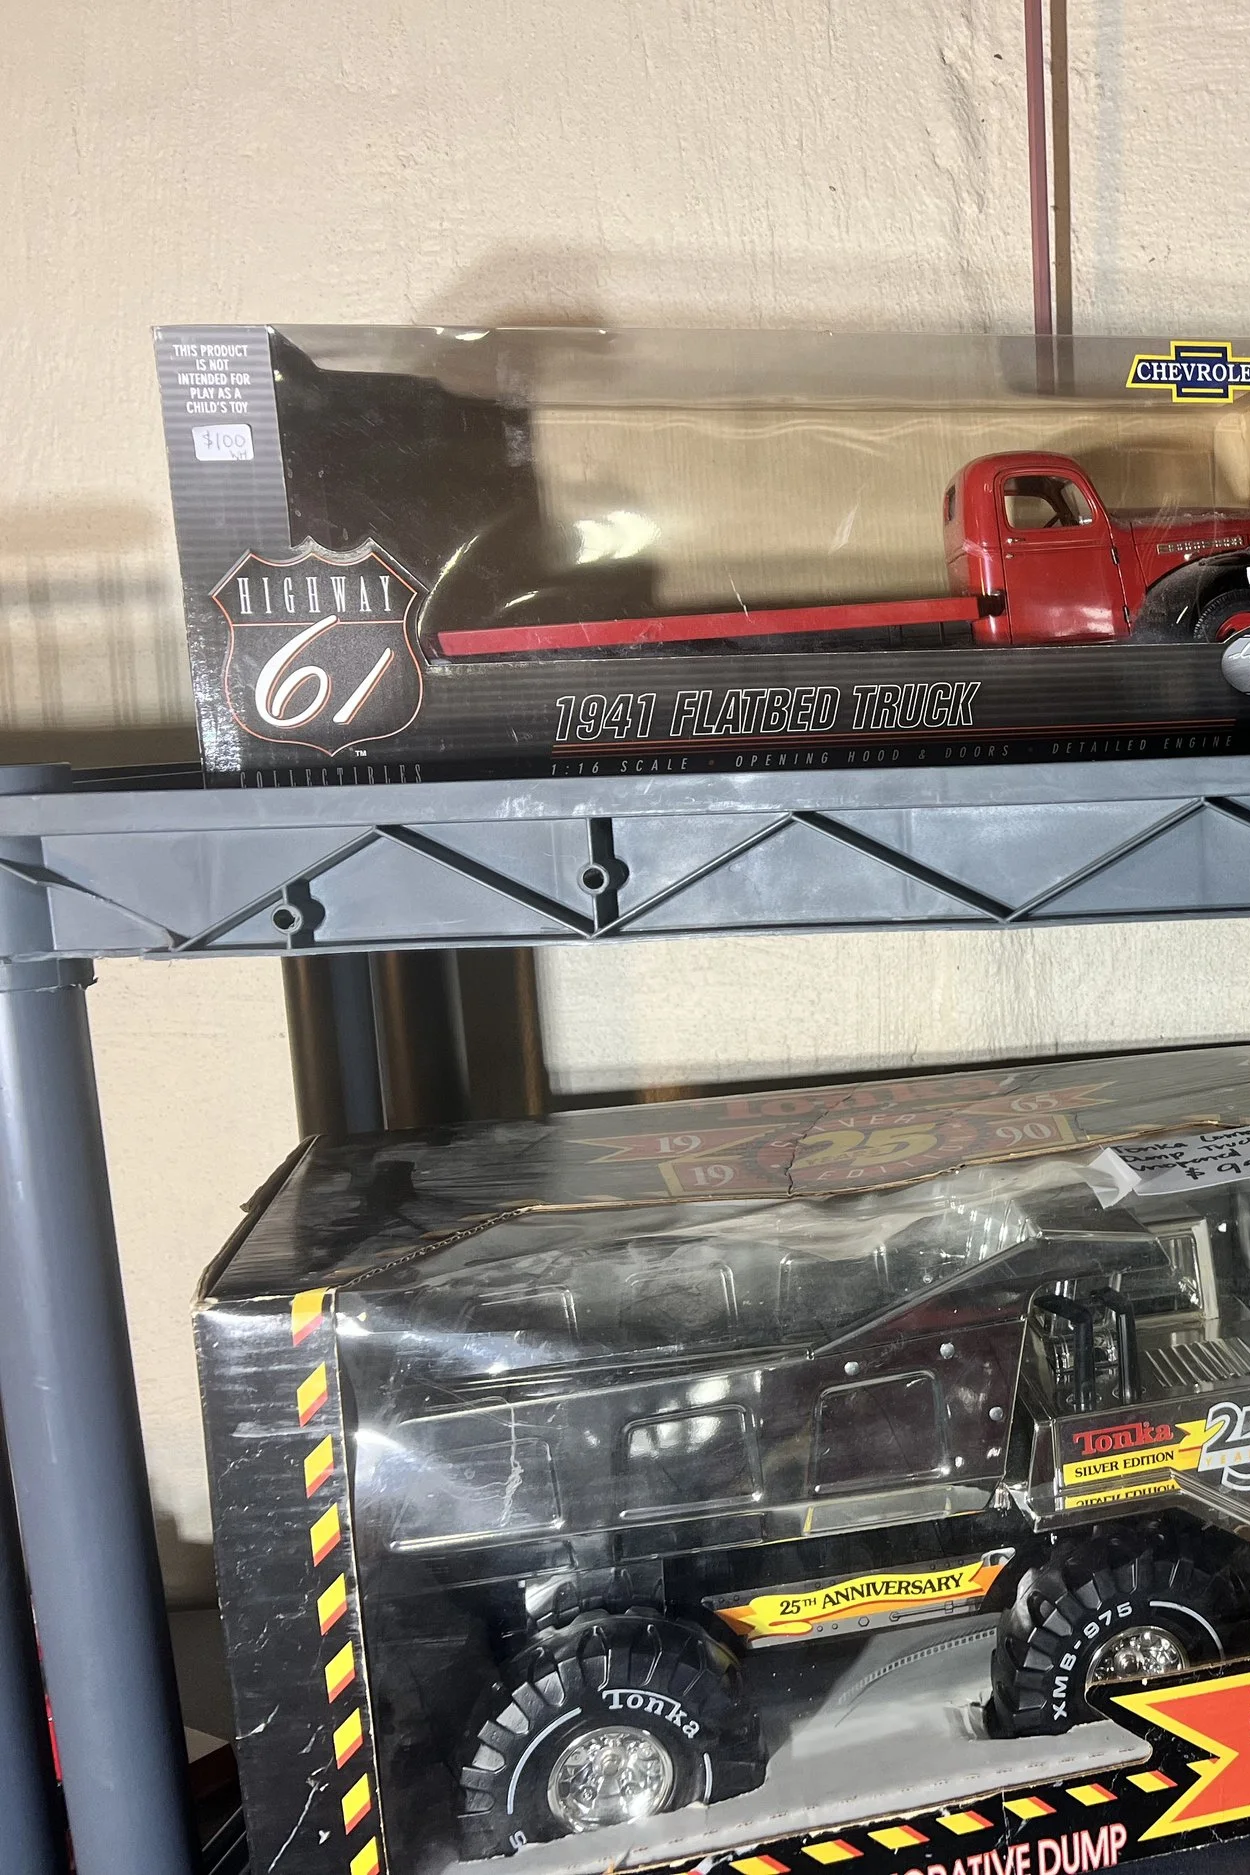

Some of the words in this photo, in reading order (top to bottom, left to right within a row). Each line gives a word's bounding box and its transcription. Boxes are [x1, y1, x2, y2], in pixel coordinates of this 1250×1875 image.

[172, 344, 198, 357] THIS
[200, 344, 248, 357] PRODUCT
[195, 359, 207, 371] IS
[209, 359, 230, 371] NOT
[178, 373, 227, 385] INTENDED
[230, 373, 251, 385] FOR
[190, 387, 215, 399] PLAY
[218, 387, 231, 399] AS
[234, 387, 242, 399] A
[186, 401, 228, 414] CHILD'S
[229, 401, 249, 414] TOY
[202, 430, 246, 450] $100
[237, 576, 392, 614] HIGHWAY
[255, 614, 395, 730] 61
[555, 692, 657, 741] 1941
[669, 686, 841, 736] FLATBED
[852, 681, 982, 730] TRUCK
[551, 761, 601, 776] 1:16
[620, 757, 688, 773] SCALE
[735, 751, 830, 768] OPENING
[848, 747, 901, 763] HOOD
[917, 748, 927, 760] &
[945, 744, 1010, 759] DOORS
[1052, 737, 1149, 755] DETAILED
[1163, 735, 1234, 750] ENGINE
[240, 763, 422, 788] COLLECTIBLES
[1011, 1094, 1059, 1112] 65
[655, 1134, 702, 1155] 19
[790, 1122, 938, 1170] 25
[996, 1122, 1052, 1148] 90
[1110, 1142, 1189, 1154] Tonka
[1120, 1151, 1185, 1163] Dump
[689, 1164, 735, 1189] 19
[1072, 1421, 1174, 1456] Tonka
[1074, 1461, 1119, 1478] SILVER
[1123, 1450, 1175, 1470] EDITION
[780, 1597, 817, 1616] 25TH
[822, 1573, 964, 1609] ANNIVERSARY
[1052, 1602, 1133, 1721] XMB-975
[602, 1689, 700, 1739] Tonka
[1037, 1822, 1128, 1875] DUMP
